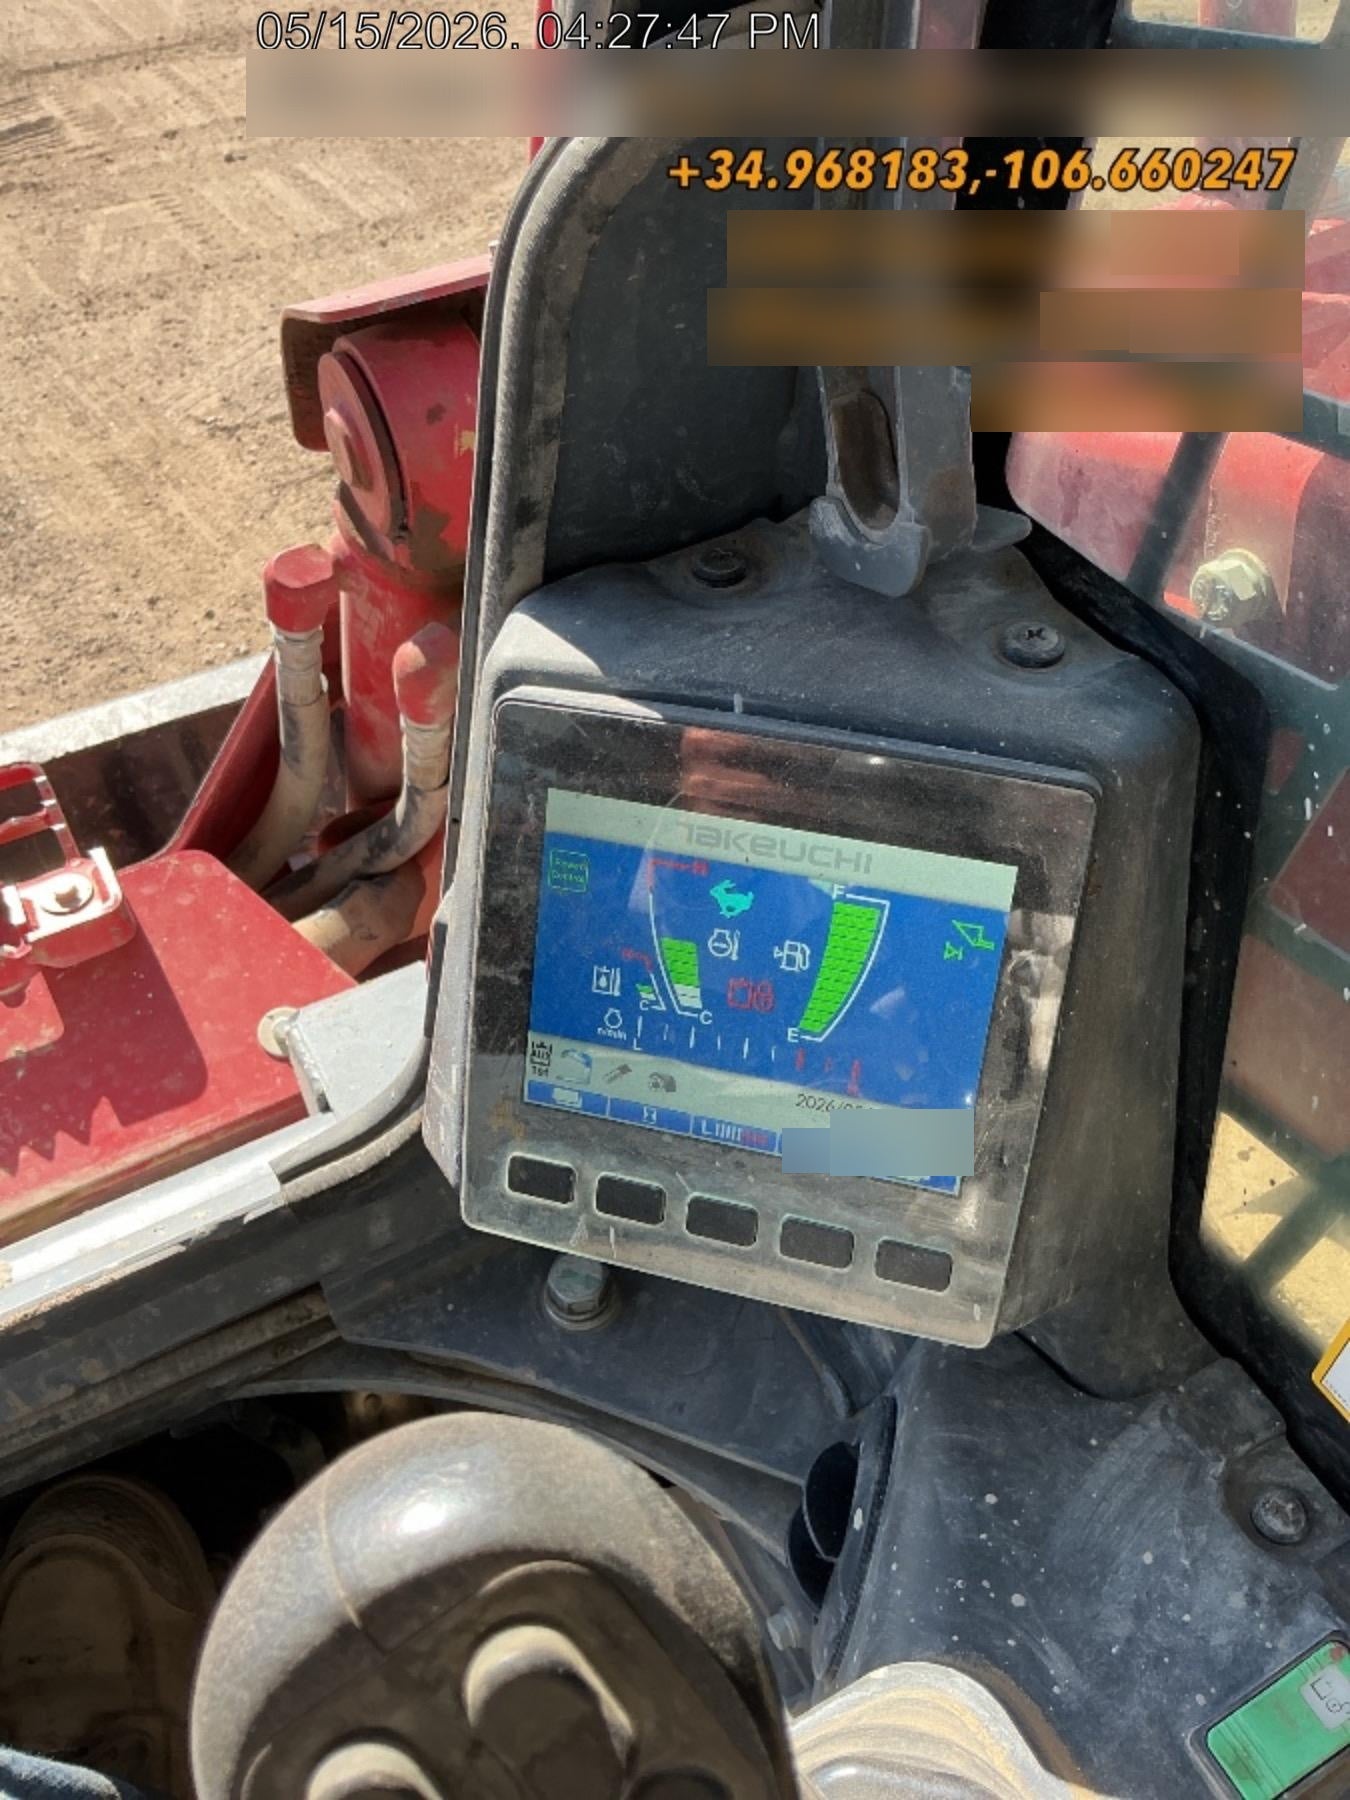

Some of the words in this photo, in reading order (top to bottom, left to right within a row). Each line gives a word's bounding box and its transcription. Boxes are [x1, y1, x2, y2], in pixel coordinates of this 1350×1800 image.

[831, 884, 846, 900] F
[699, 1010, 713, 1025] C
[787, 1027, 800, 1043] E
